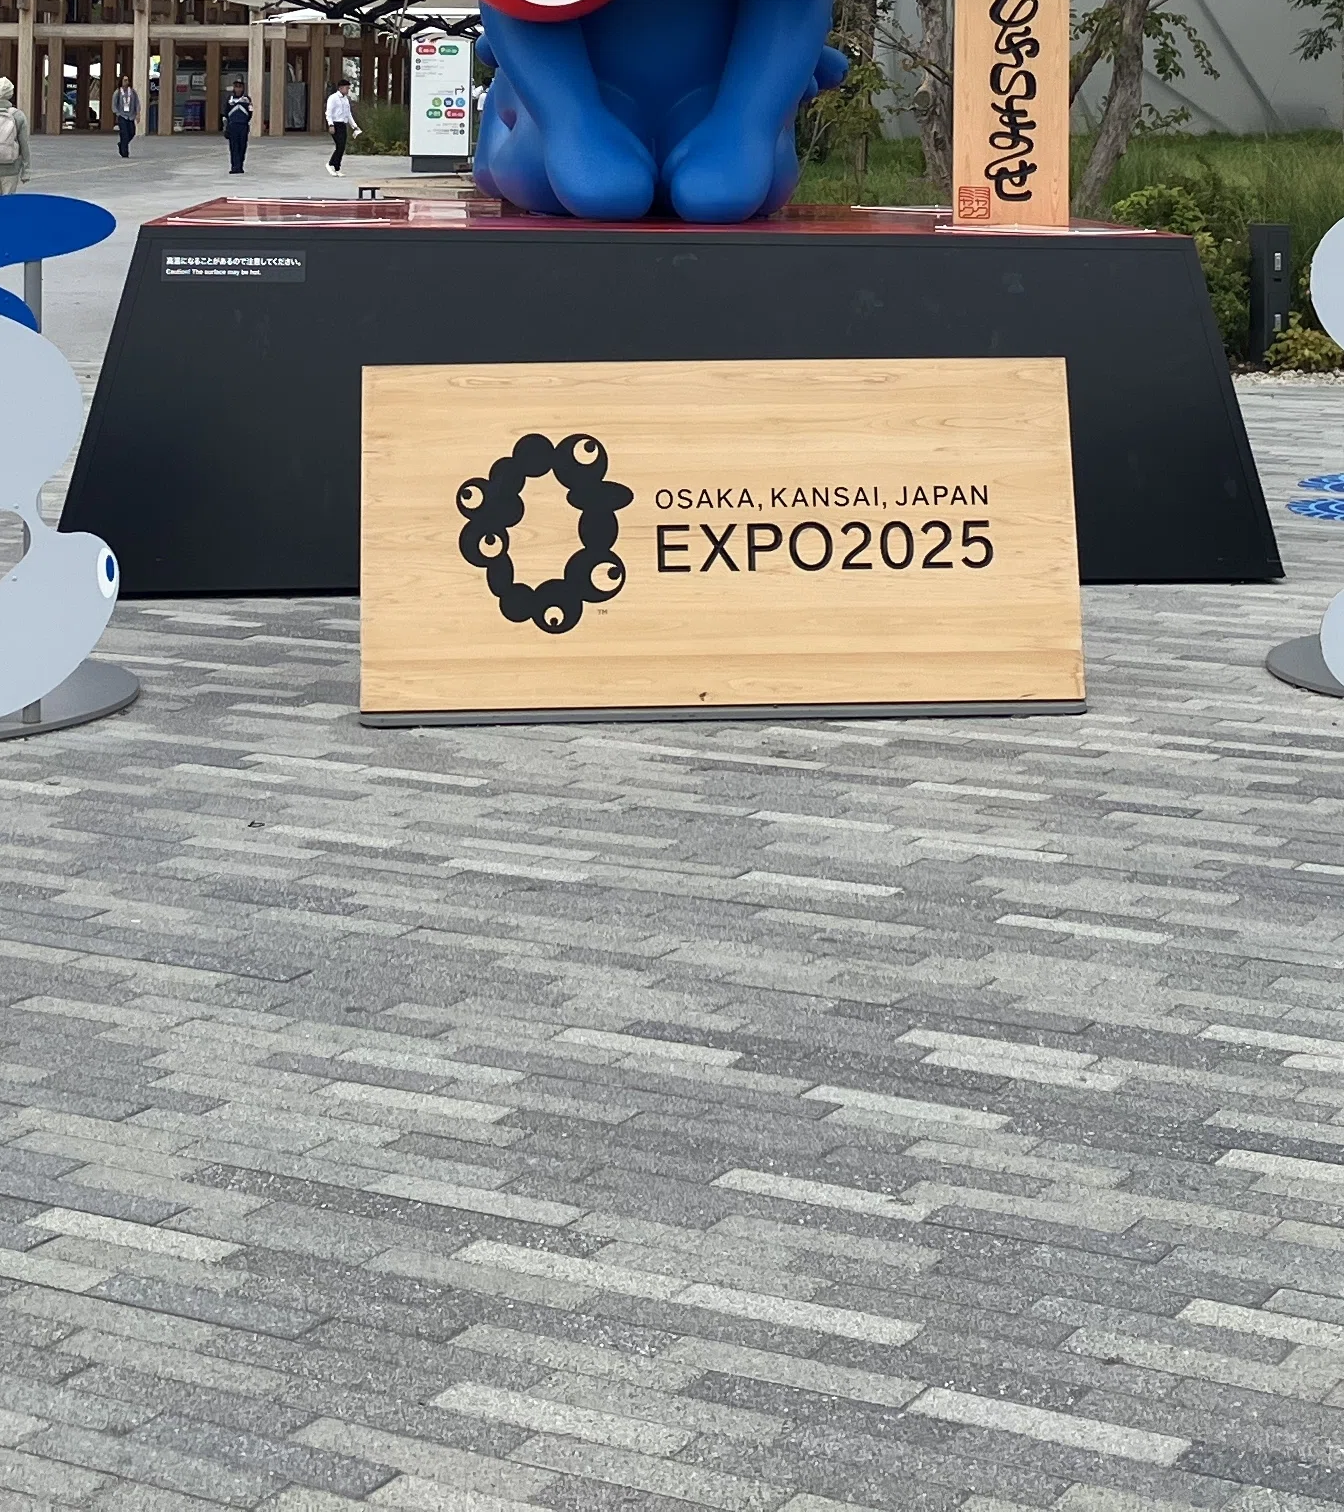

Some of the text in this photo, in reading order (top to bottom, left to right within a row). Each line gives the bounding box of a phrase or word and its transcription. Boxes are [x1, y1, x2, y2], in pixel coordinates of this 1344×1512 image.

[655, 485, 989, 511] OSAKA, KANSAI, JAPAN
[656, 520, 994, 573] EXPO2025
